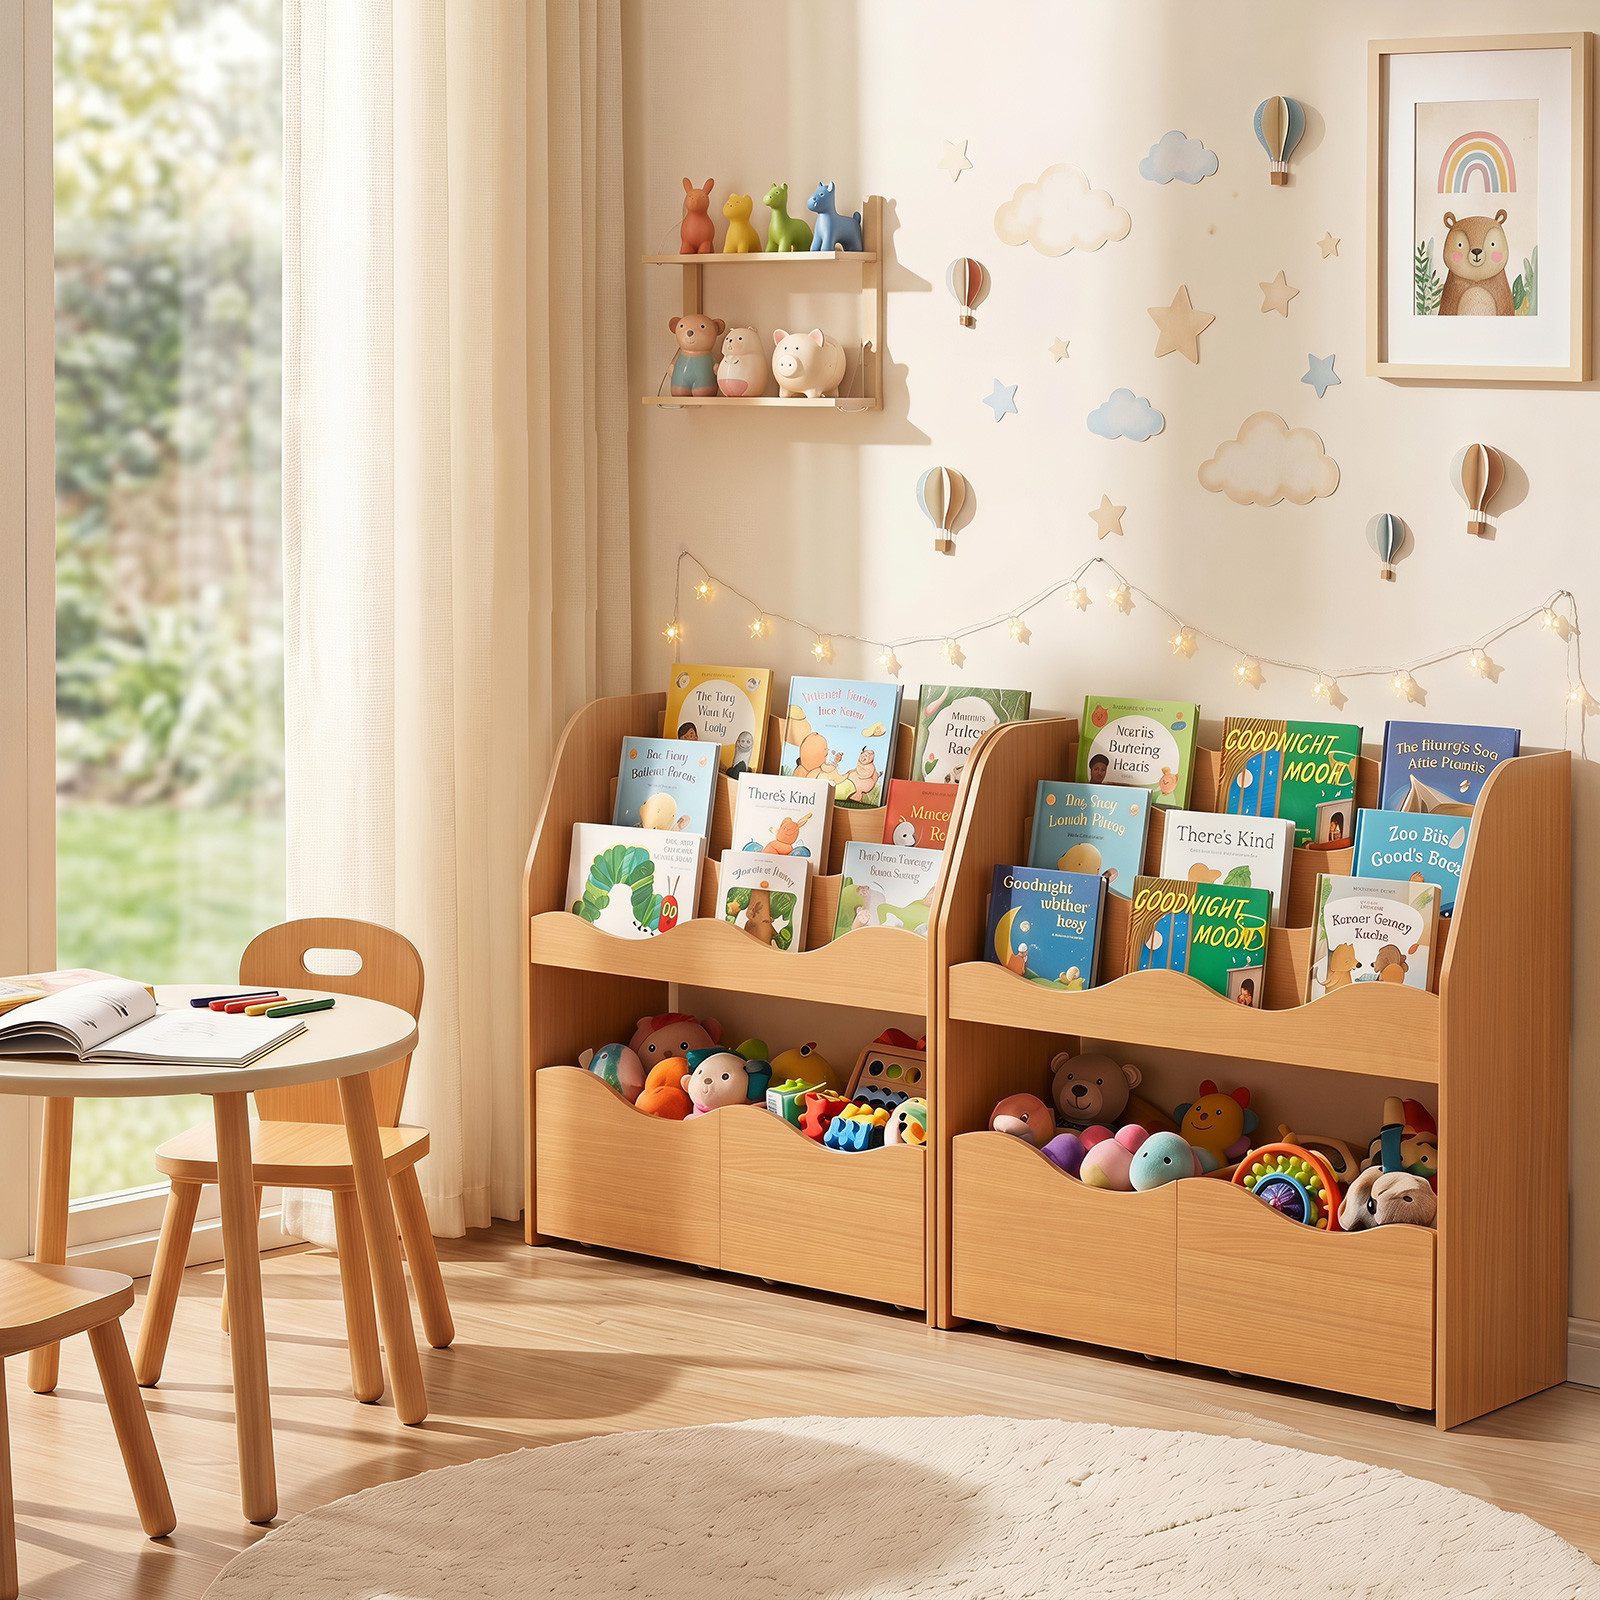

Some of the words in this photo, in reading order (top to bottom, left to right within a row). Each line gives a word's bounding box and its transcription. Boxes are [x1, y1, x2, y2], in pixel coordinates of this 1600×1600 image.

[1224, 729, 1340, 756] GOODNIGHT
[1395, 742, 1419, 755] The
[748, 786, 786, 803] There's
[789, 790, 816, 805] Kind
[1176, 825, 1232, 846] There's
[1236, 830, 1275, 850] Kind
[1388, 825, 1418, 843] Zoo
[1371, 847, 1423, 867] Good's
[1003, 875, 1073, 896] Goodnight
[1134, 889, 1250, 920] GOODNIGHT
[1193, 924, 1255, 949] MOON
